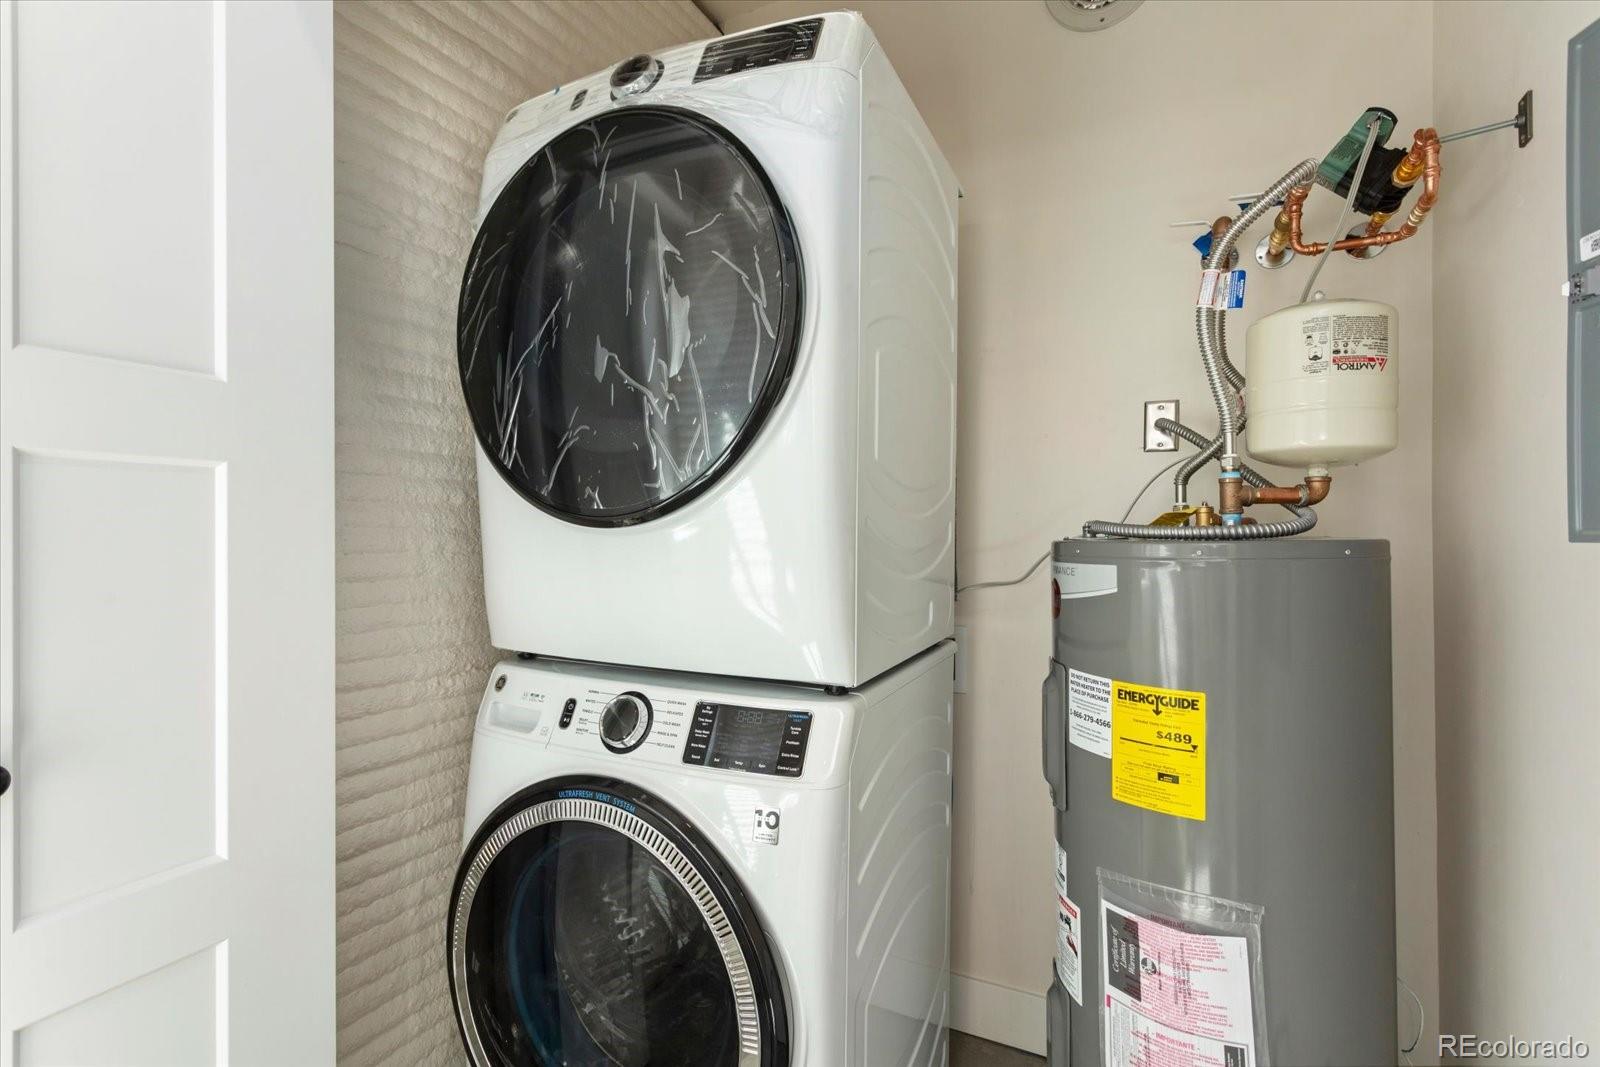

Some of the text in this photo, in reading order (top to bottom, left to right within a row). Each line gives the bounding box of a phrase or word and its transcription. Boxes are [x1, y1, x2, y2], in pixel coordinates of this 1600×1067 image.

[1337, 362, 1376, 371] AMTROL
[1084, 676, 1099, 685] RETURN
[1081, 683, 1095, 691] HEATER
[1087, 692, 1109, 703] PURCHASE
[1156, 730, 1192, 744] $489
[559, 790, 636, 813] ULTRAFRESH VENT SYSTEM
[755, 810, 779, 829] 10
[1156, 1032, 1195, 1050] IMPORTANTE
